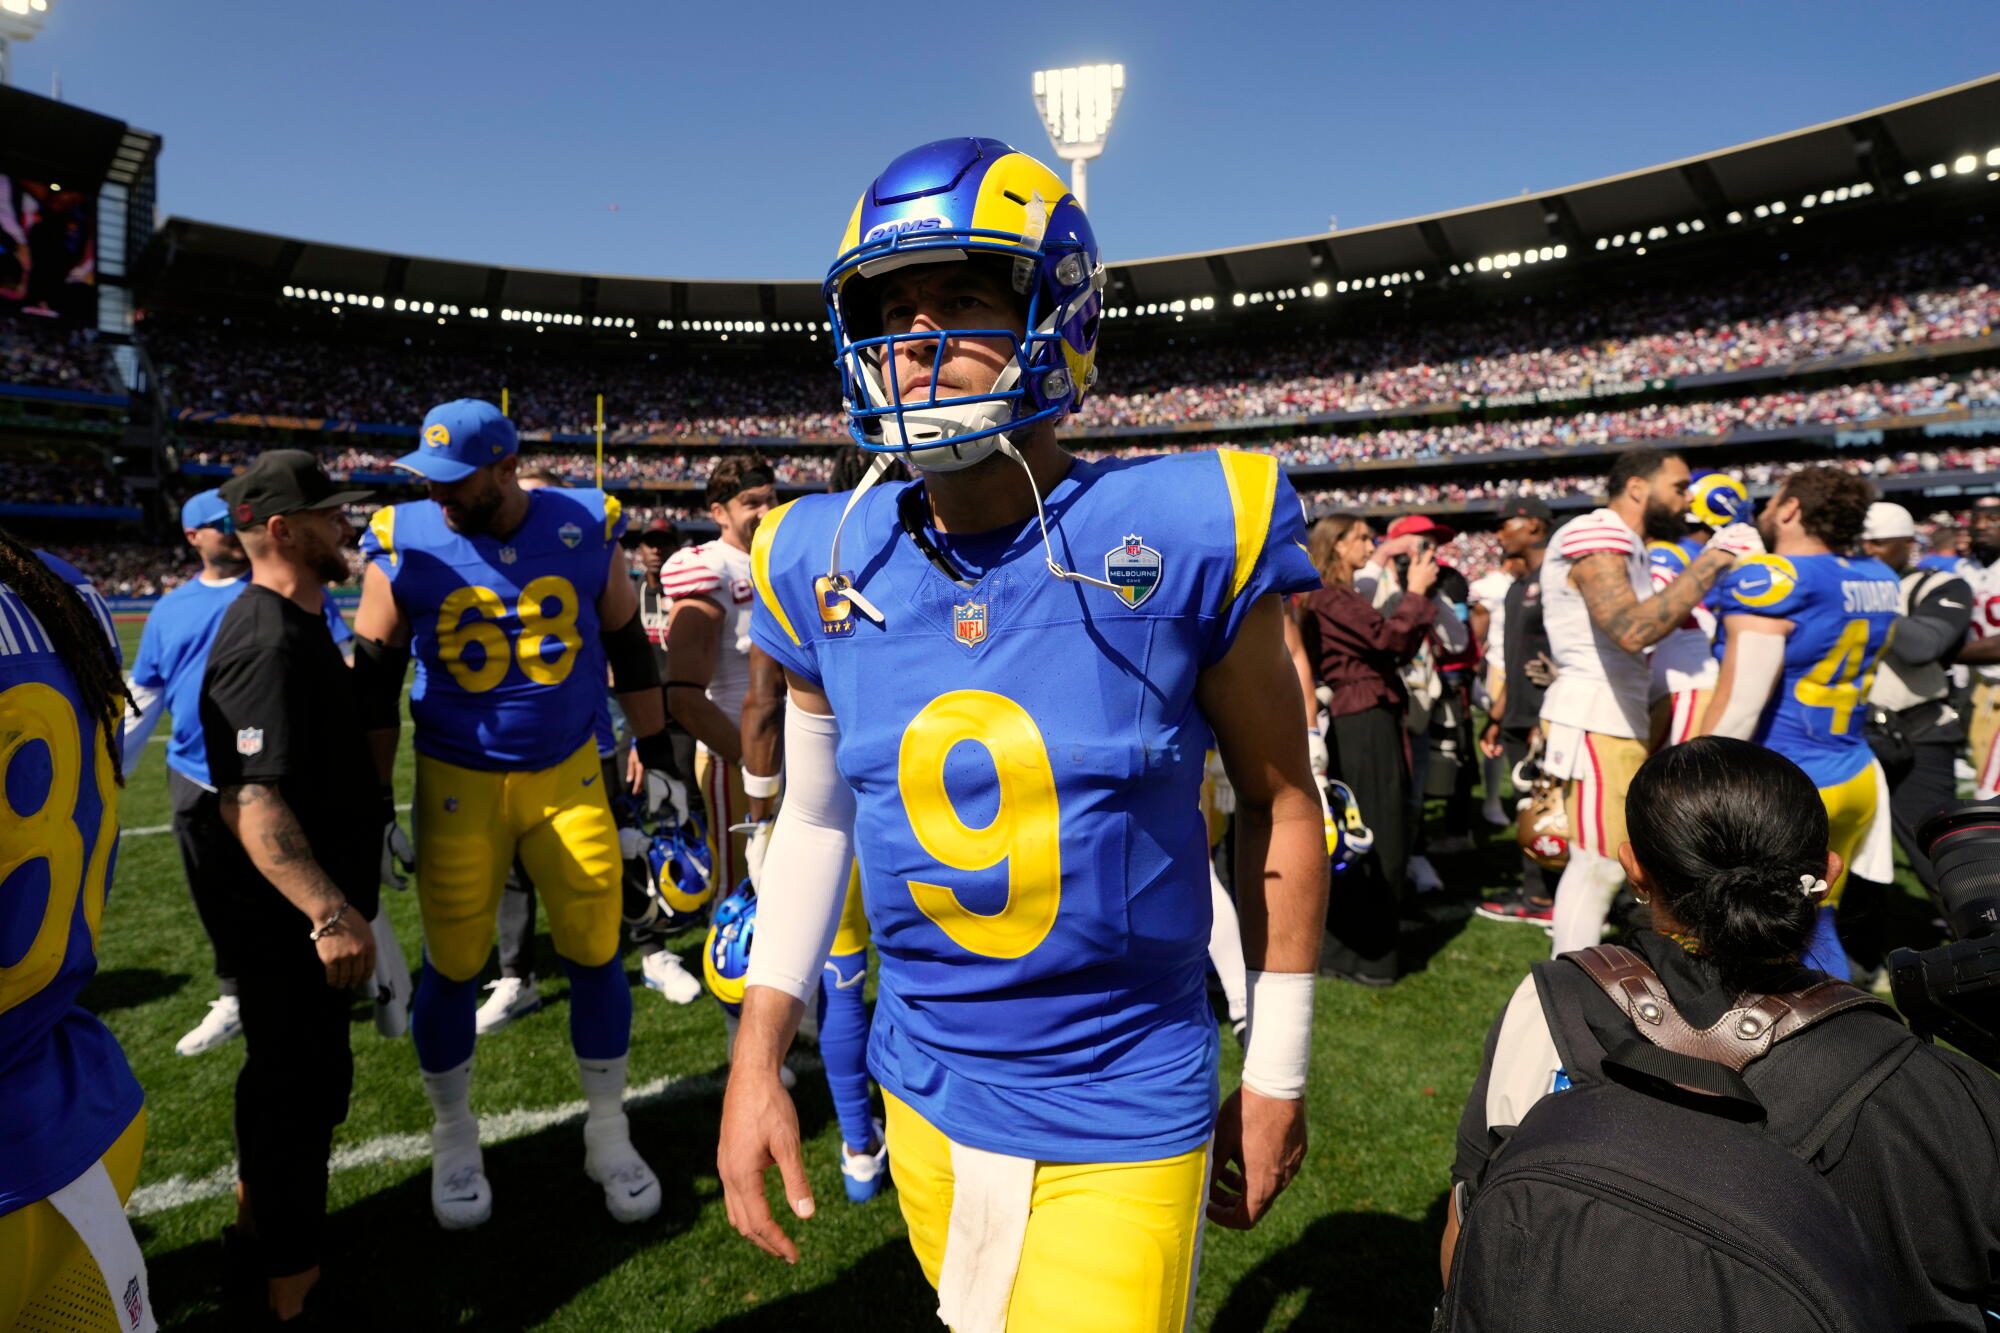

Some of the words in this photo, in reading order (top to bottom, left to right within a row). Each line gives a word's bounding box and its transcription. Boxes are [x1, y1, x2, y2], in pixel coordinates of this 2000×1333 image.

[869, 217, 941, 241] RAMS
[434, 574, 583, 693] 68
[959, 620, 982, 639] NFL
[898, 689, 1061, 959] 9
